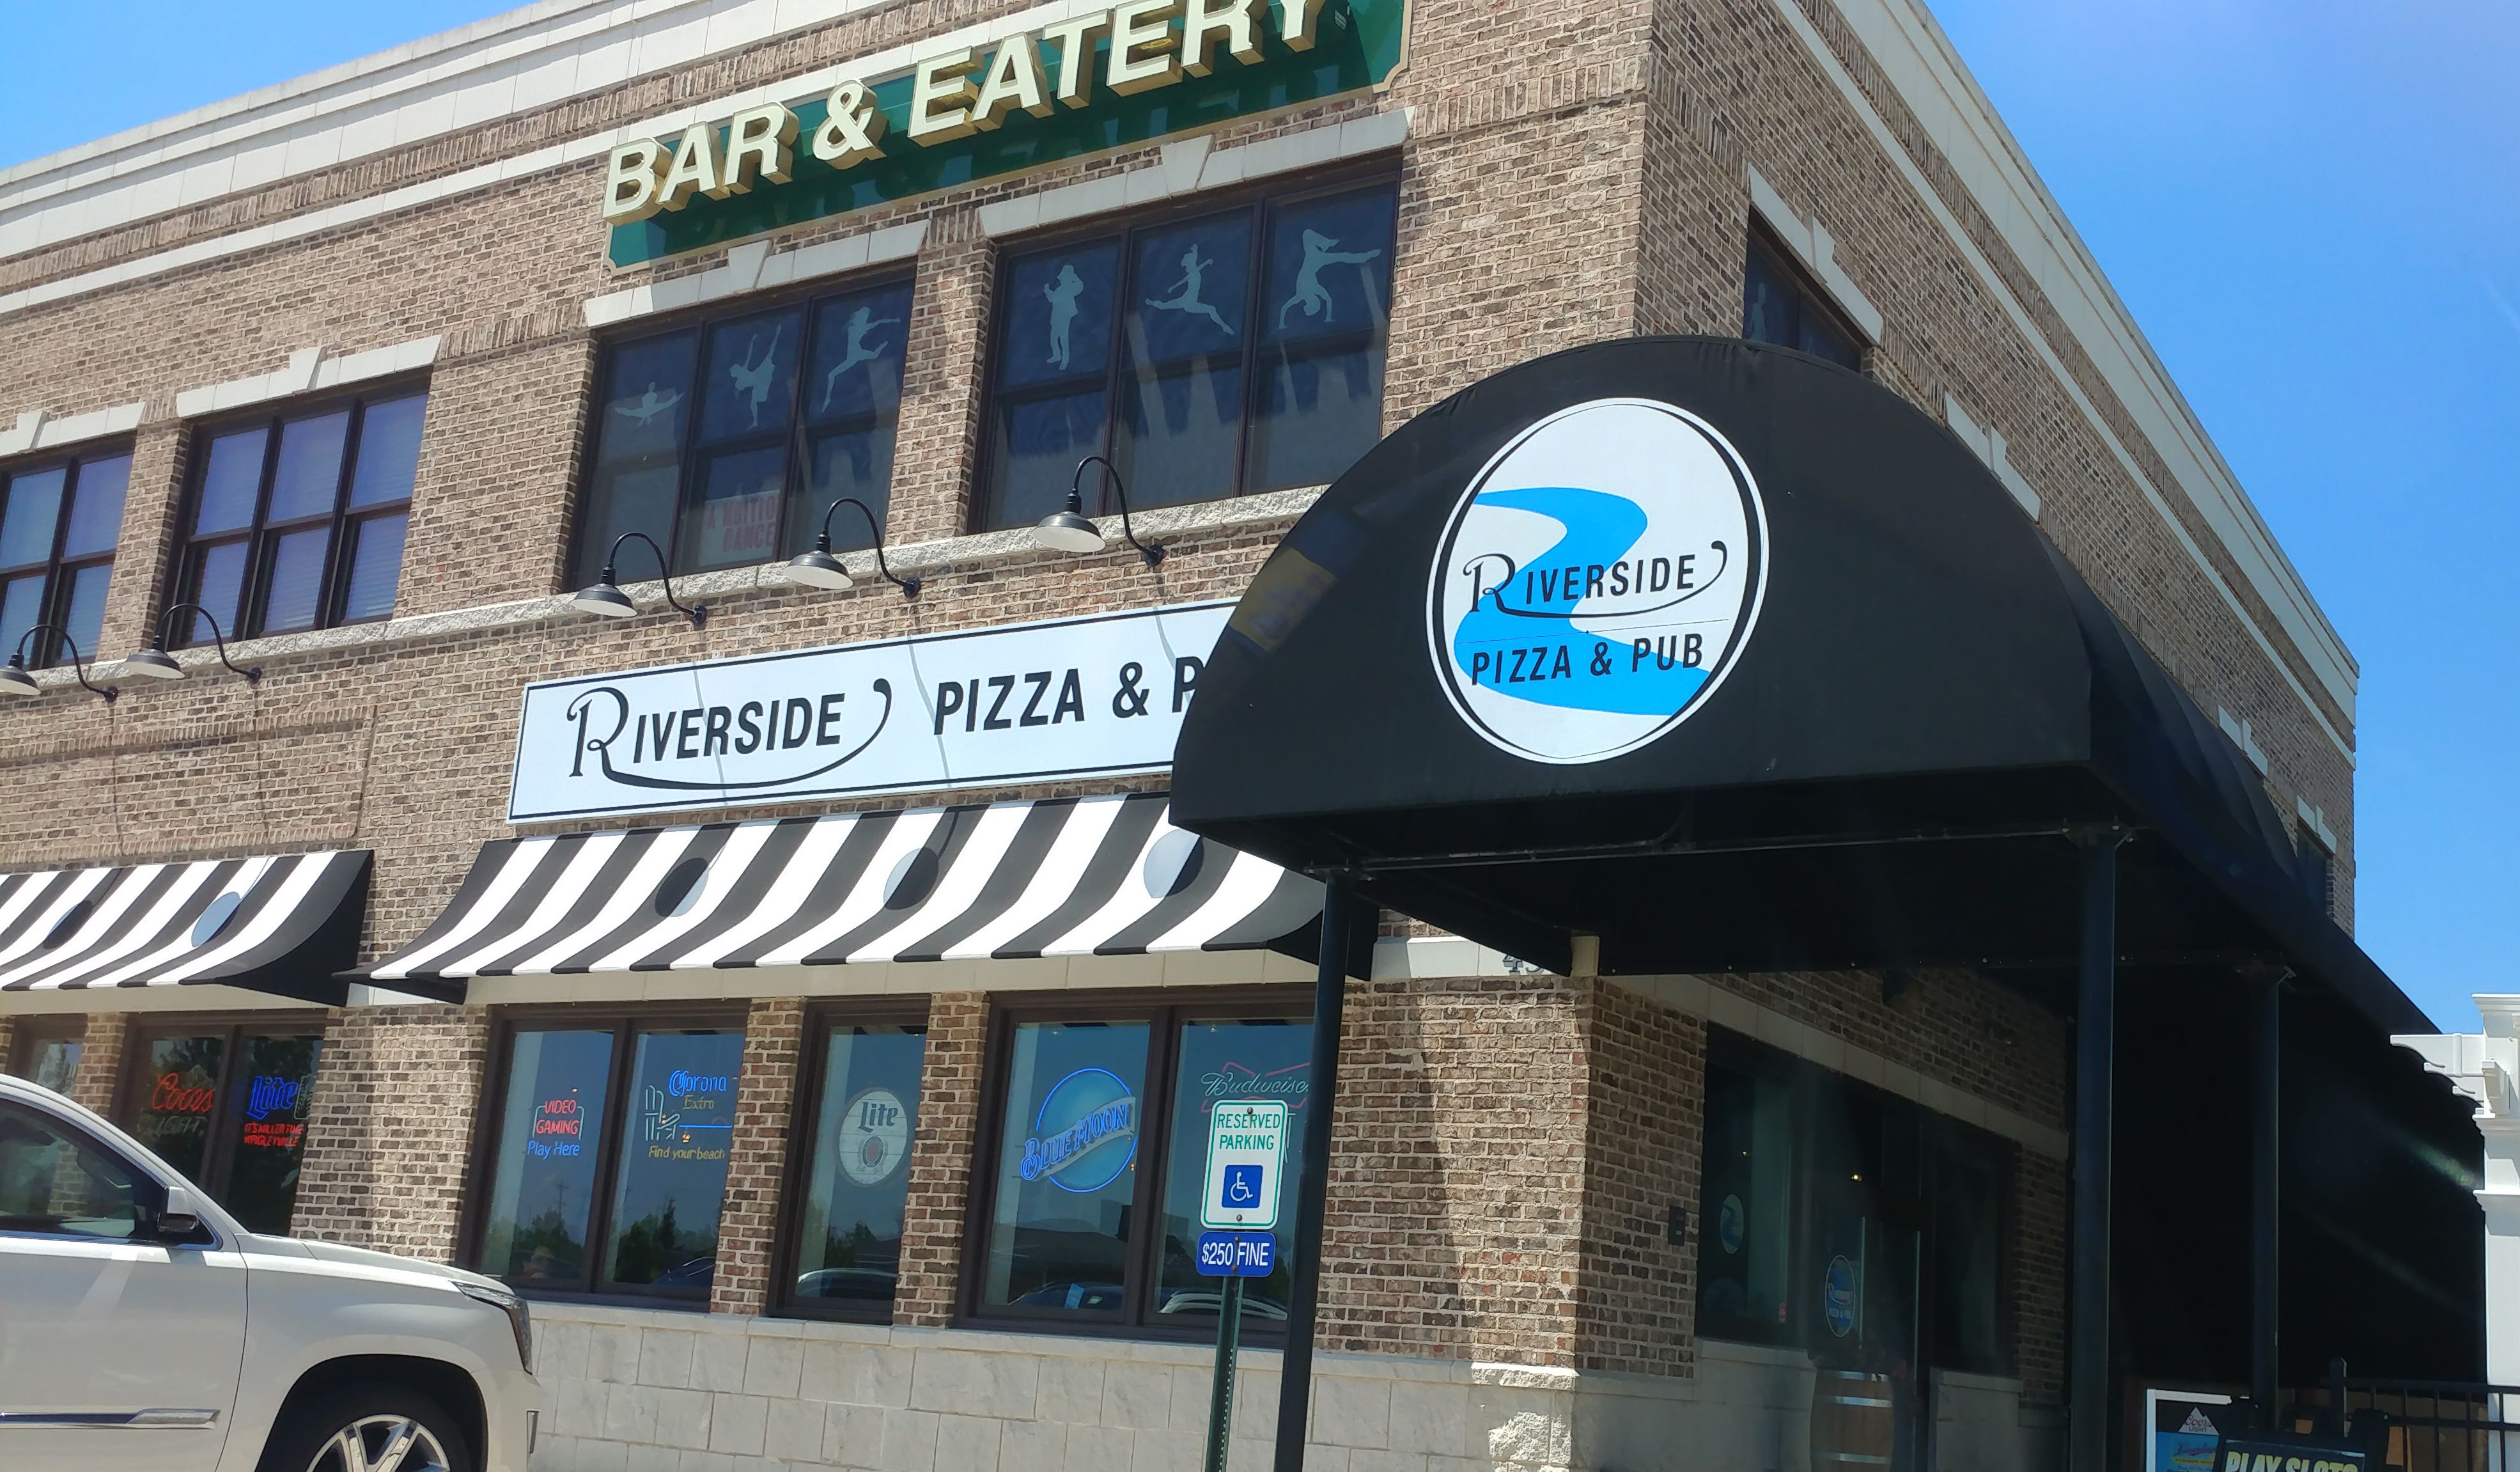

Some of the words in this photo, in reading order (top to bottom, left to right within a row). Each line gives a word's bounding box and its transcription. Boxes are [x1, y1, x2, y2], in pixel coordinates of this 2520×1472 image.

[602, 100, 798, 225] BAR
[813, 79, 887, 169] &
[1472, 645, 1571, 685] PIZZA
[1590, 641, 1612, 676] &
[1631, 633, 1703, 672] PUB
[934, 668, 1085, 735] PIZZA
[1112, 662, 1149, 718] &
[152, 1072, 214, 1113] Coors
[669, 1069, 727, 1097] Corona
[1201, 1071, 1309, 1097] Budweise
[247, 1075, 299, 1120] Lite
[544, 1099, 577, 1115] VIDEO
[682, 1094, 715, 1111] Extra
[535, 1119, 580, 1135] GAMING
[857, 1101, 898, 1133] Lite
[1217, 1113, 1280, 1129] RESERVED
[527, 1141, 552, 1160] Play
[554, 1141, 580, 1157] Here
[648, 1145, 669, 1159] Find
[672, 1149, 697, 1160] your
[696, 1147, 726, 1161] beach
[1020, 1129, 1072, 1181] BLUE
[1073, 1102, 1129, 1151] MOON
[1218, 1134, 1275, 1151] PARKING
[1201, 1242, 1234, 1265] $250
[1236, 1242, 1270, 1267] FINE
[2185, 1414, 2213, 1427] Coors
